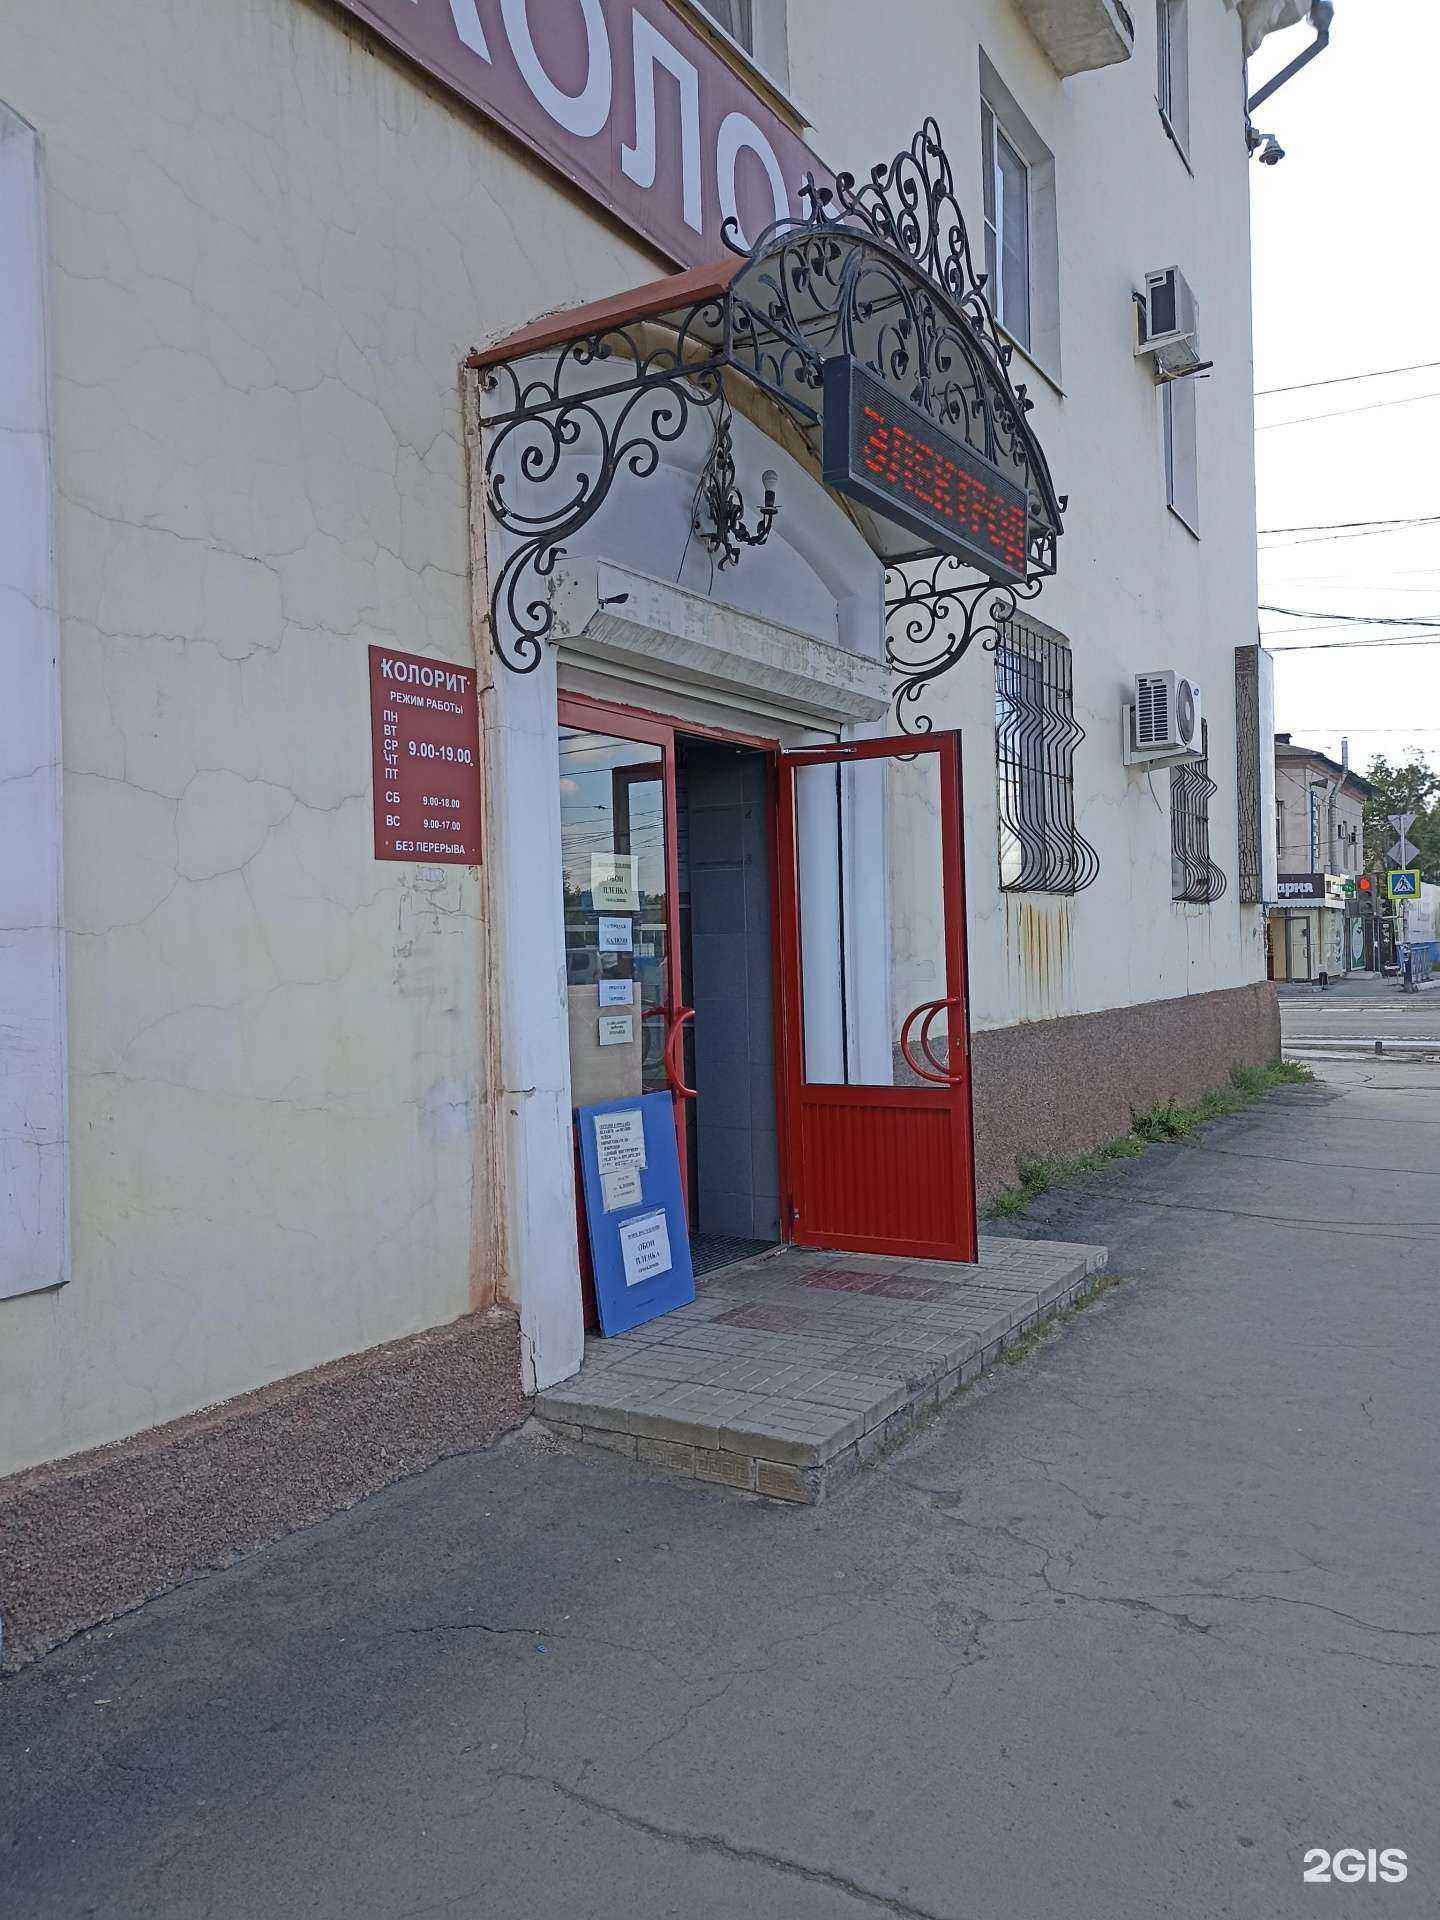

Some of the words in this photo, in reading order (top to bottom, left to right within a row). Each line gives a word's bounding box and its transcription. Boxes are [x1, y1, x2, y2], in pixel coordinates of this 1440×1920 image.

[402, 0, 843, 251] ОЛО
[381, 658, 467, 693] КОЛОРИТ
[390, 691, 424, 707] РЕЖИМ
[427, 698, 463, 714] РАБОТЫ
[383, 710, 398, 722] ПН
[384, 724, 397, 736] ВТ
[384, 739, 398, 750] СР
[408, 741, 471, 763] 9.00-19.00
[384, 753, 398, 765] ЧТ
[385, 768, 399, 779] ПТ
[385, 791, 400, 803] СБ
[422, 796, 460, 808] 9.00-18.00
[386, 815, 400, 826] ВС
[395, 840, 414, 851] БЕЗ
[416, 842, 466, 854] ПЕРЕРЫВА
